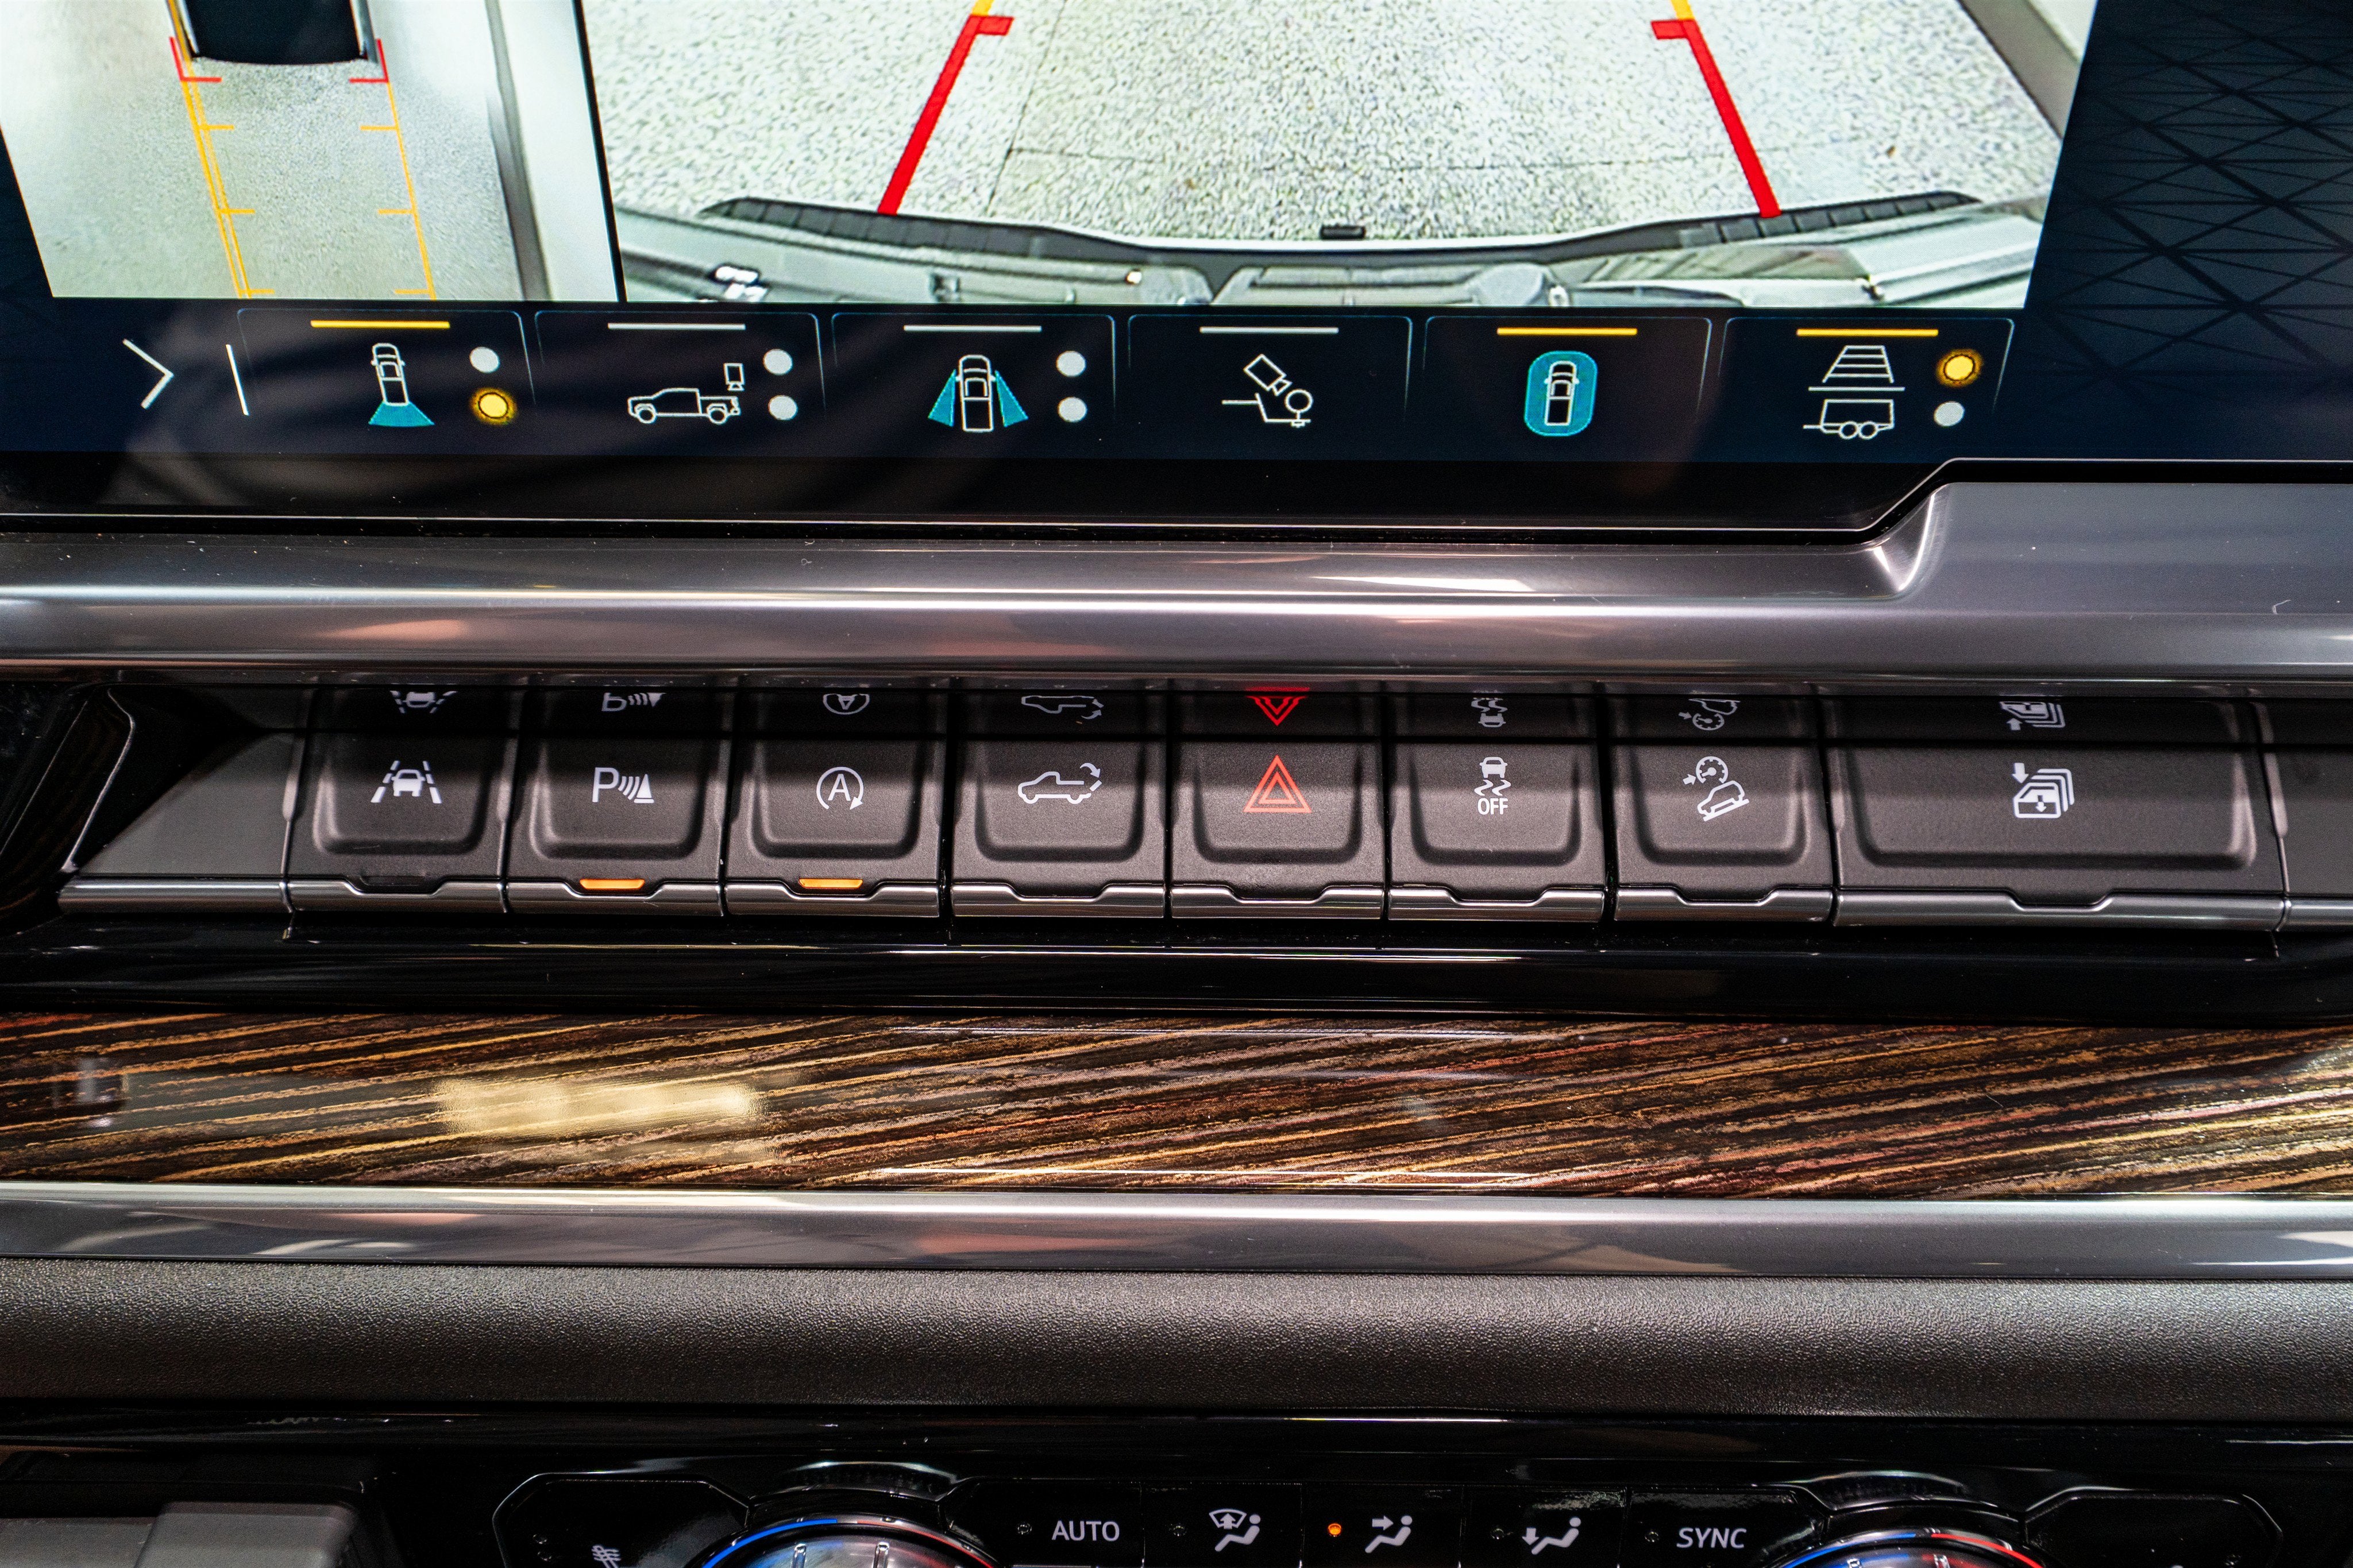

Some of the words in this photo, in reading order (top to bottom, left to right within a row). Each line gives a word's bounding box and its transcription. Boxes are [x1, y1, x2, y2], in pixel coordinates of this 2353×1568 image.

[592, 767, 619, 802] P
[827, 774, 851, 801] A
[1478, 797, 1509, 814] OFF
[1052, 1521, 1120, 1542] AUTO
[1676, 1528, 1746, 1548] SYNC
